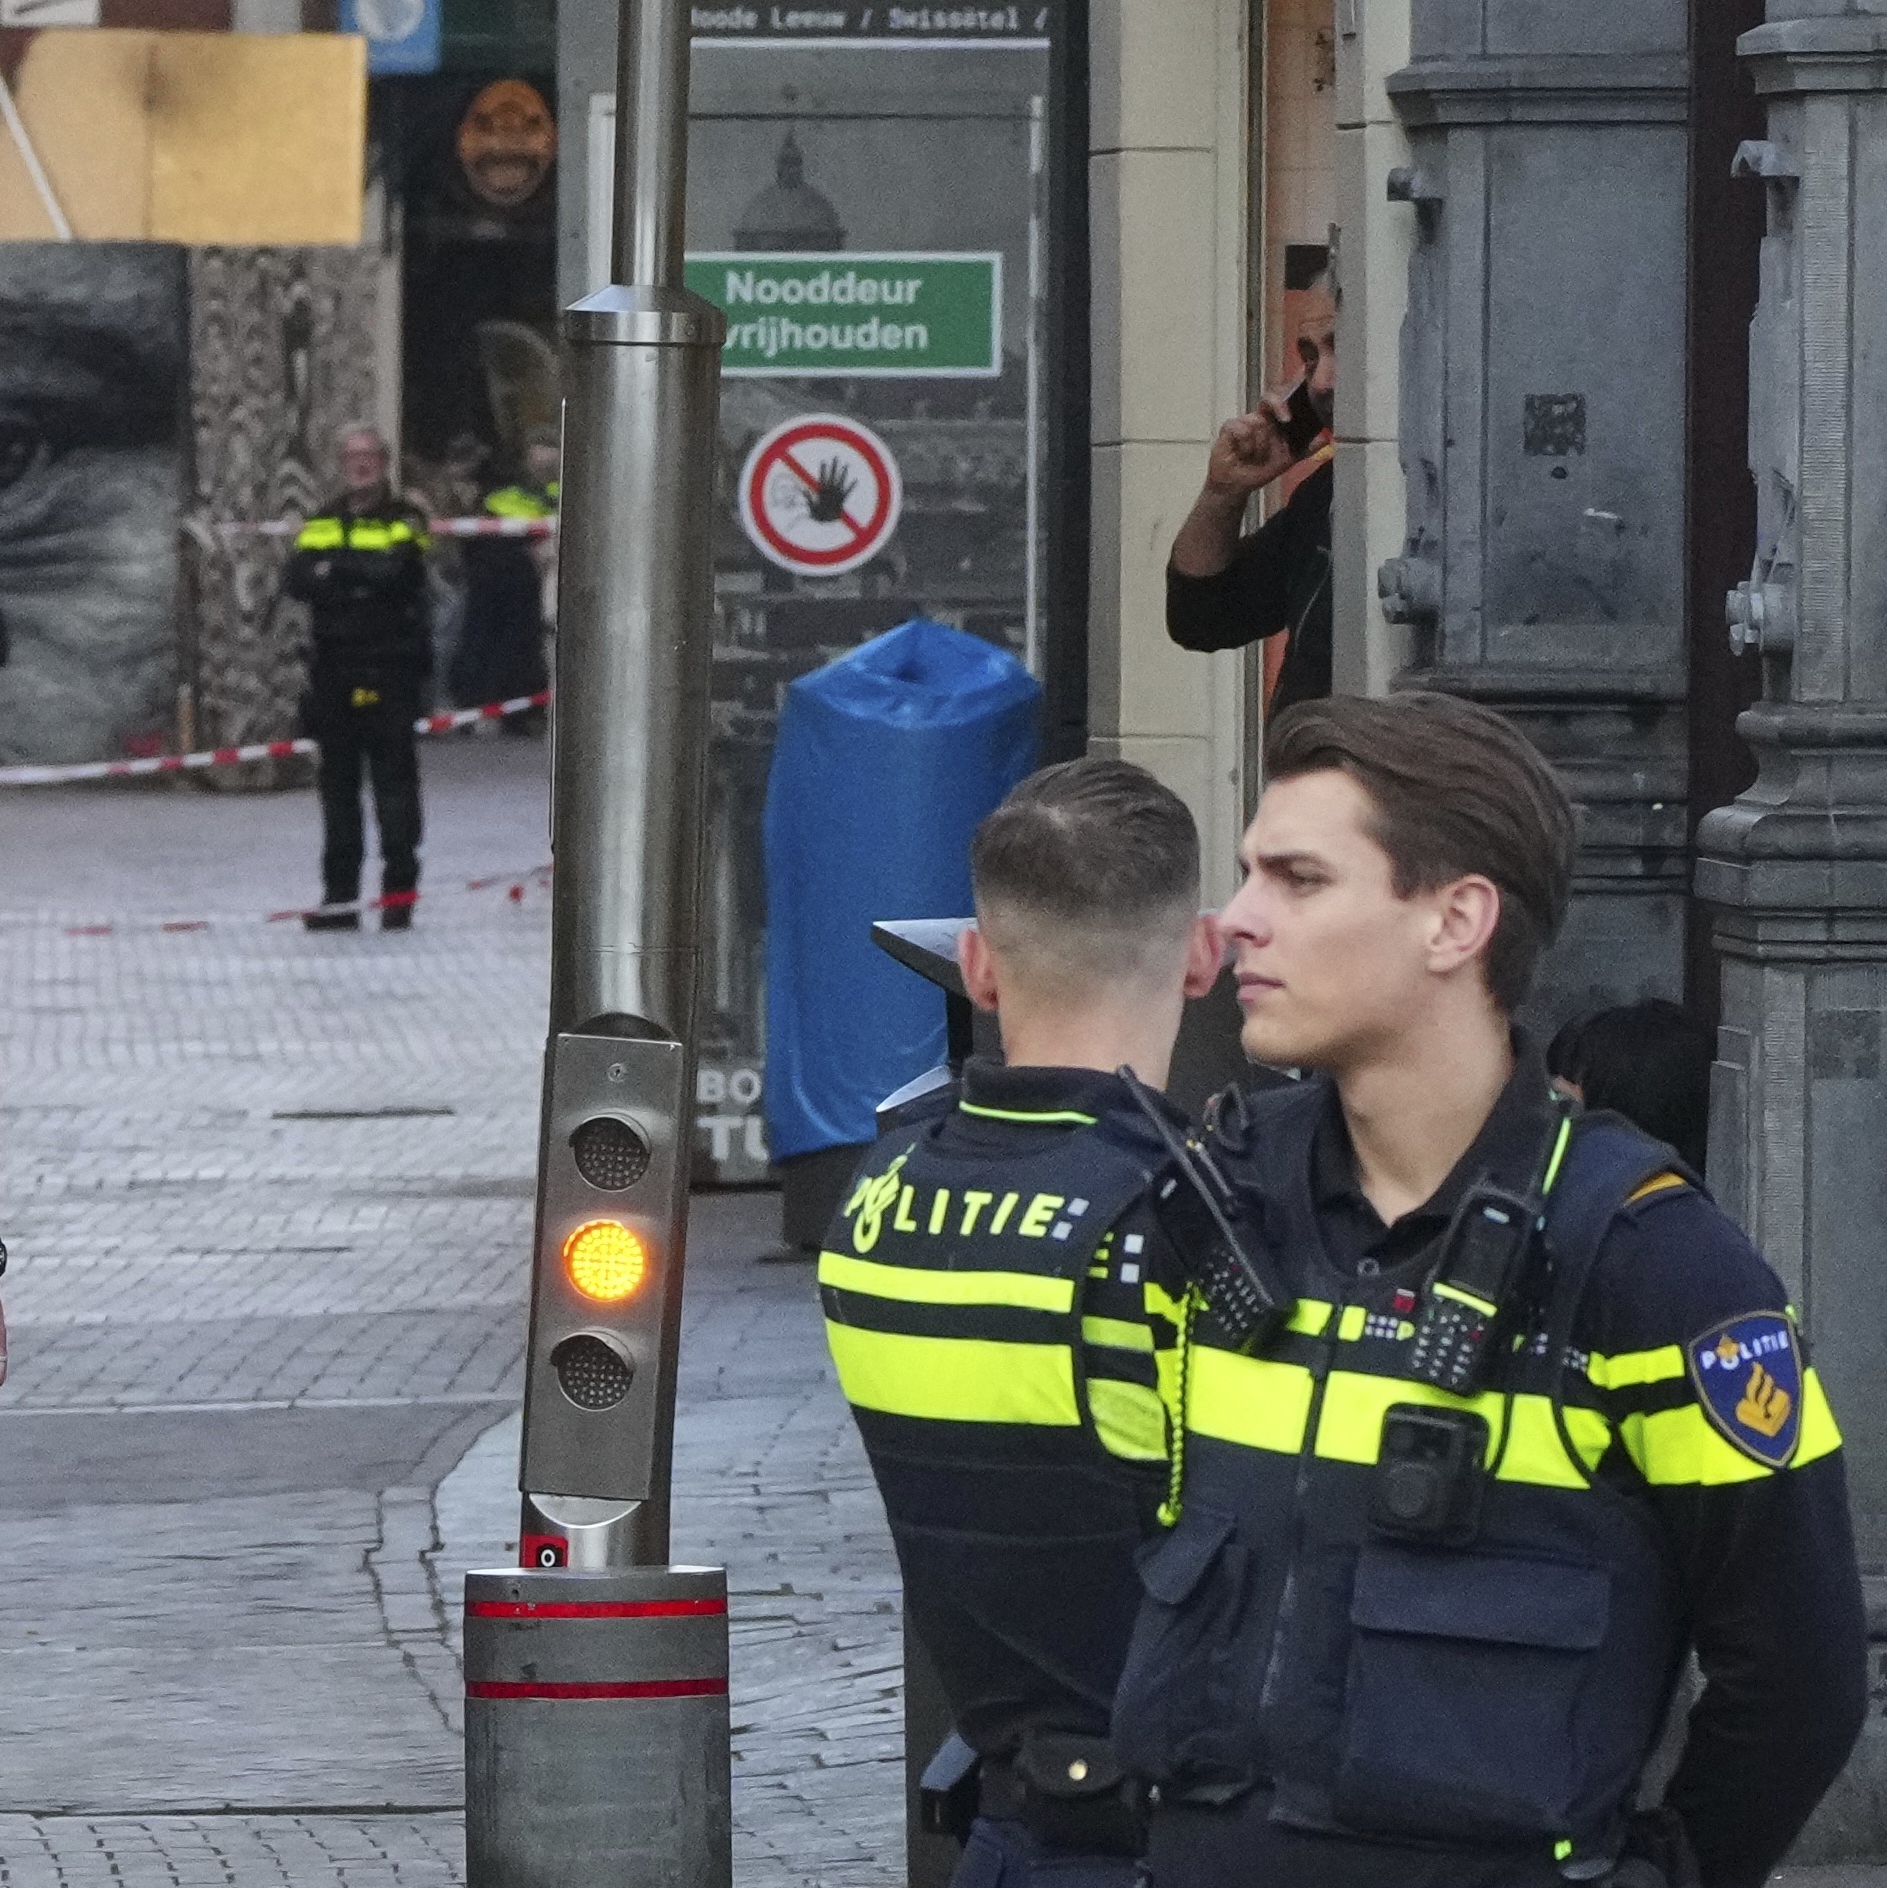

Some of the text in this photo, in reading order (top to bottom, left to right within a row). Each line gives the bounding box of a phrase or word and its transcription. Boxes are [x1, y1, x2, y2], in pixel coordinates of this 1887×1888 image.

[726, 270, 922, 304] Nooddeur
[722, 315, 928, 358] vrijhouden
[843, 1158, 1066, 1254] POLITIE
[1700, 1331, 1789, 1370] POLITIE
